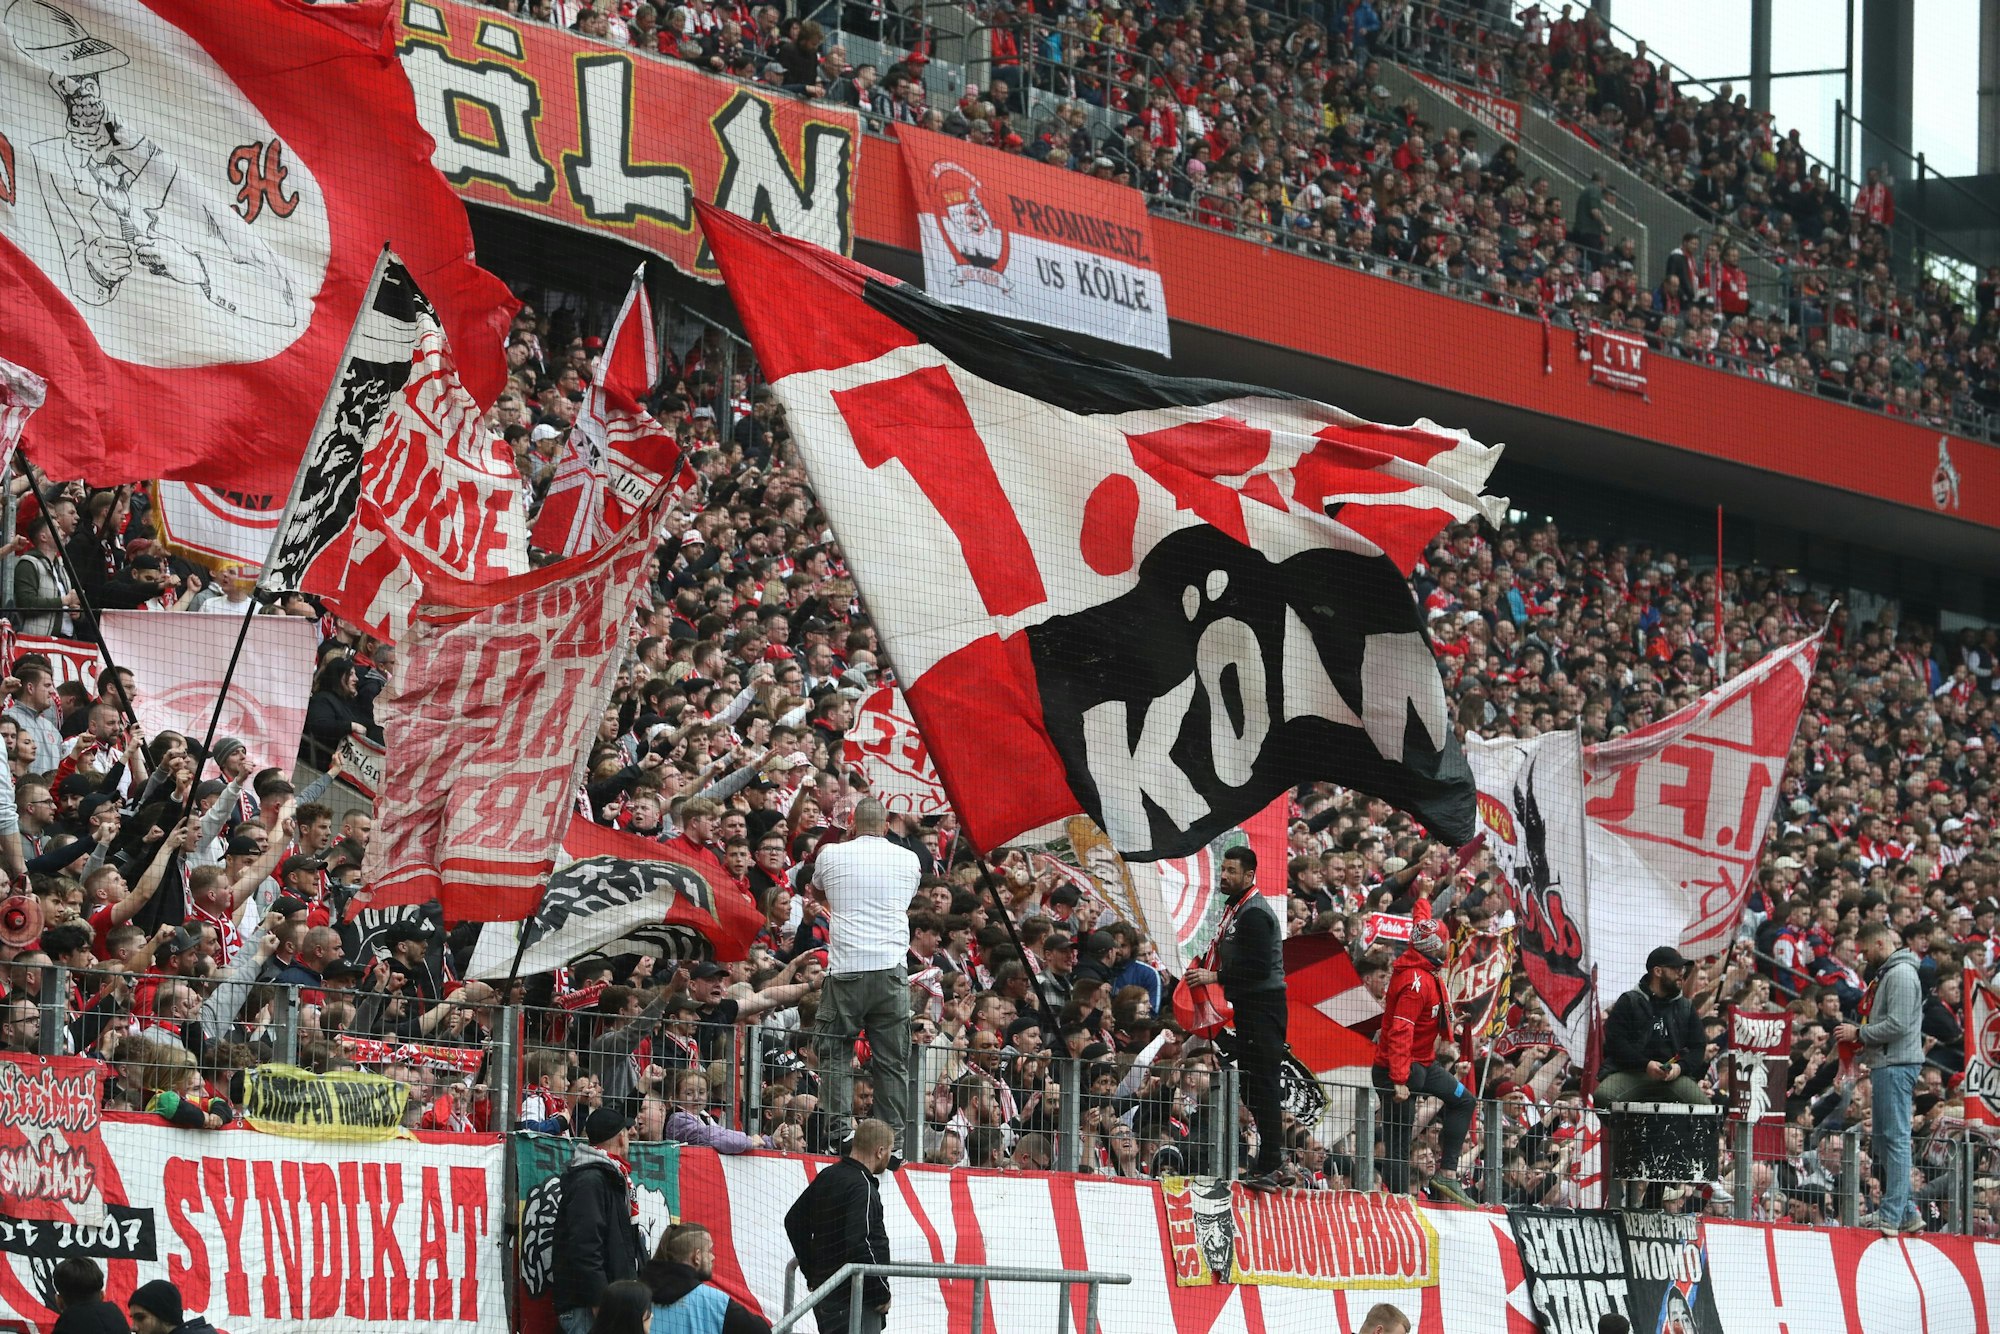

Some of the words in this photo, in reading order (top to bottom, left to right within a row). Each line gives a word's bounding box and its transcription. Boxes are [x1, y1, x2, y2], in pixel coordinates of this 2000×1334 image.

[1008, 195, 1151, 262] PROMINENZ
[1035, 257, 1065, 289] US
[1082, 568, 1447, 855] KÖLN
[163, 1155, 488, 1322] SYNDIKAT
[1231, 1181, 1430, 1279] STADIONVERBOT
[1518, 1216, 1625, 1275] SEKTION
[1623, 1212, 1662, 1239] REPOSE
[1628, 1239, 1703, 1283] MOMO
